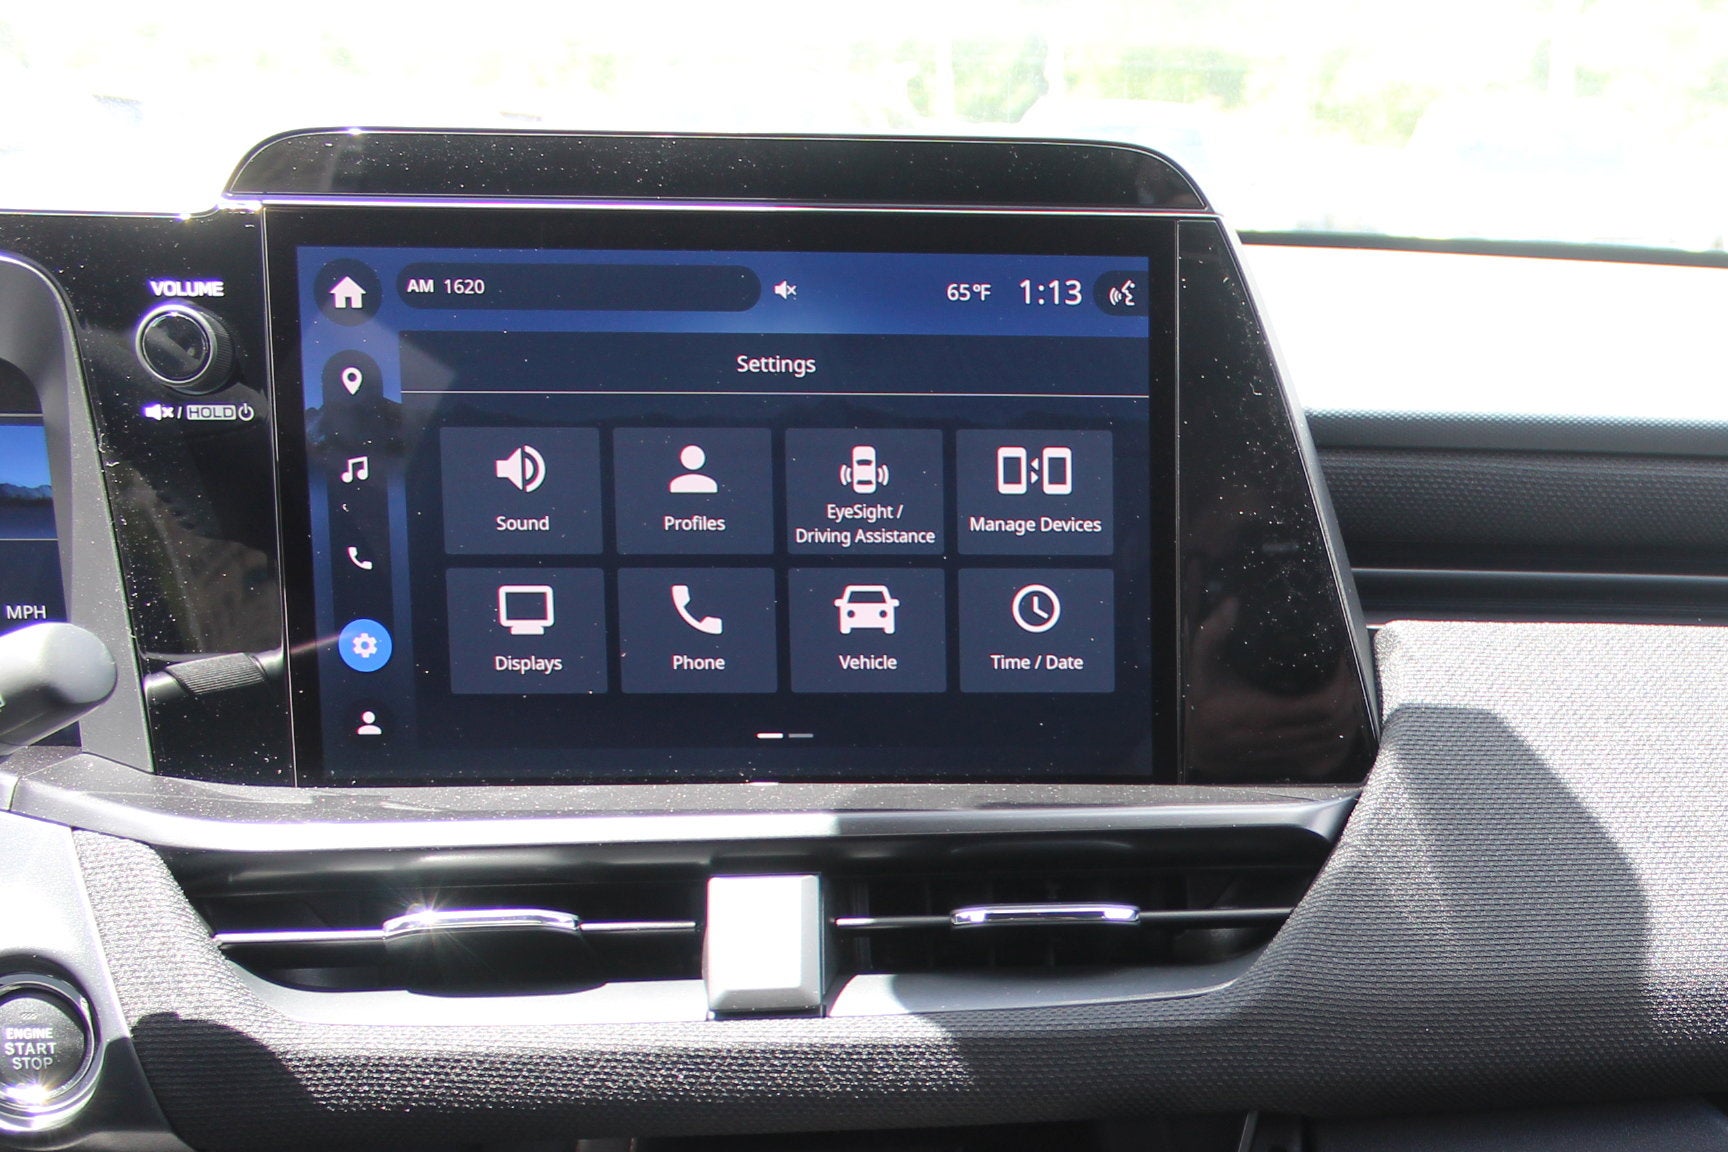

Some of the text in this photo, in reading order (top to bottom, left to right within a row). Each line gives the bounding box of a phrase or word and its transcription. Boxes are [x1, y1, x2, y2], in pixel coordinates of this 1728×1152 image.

[150, 280, 224, 298] VOLUME
[406, 279, 486, 295] AM 1620
[1019, 278, 1083, 306] 1:13
[736, 355, 816, 378] Settings
[188, 406, 235, 419] HOLD
[826, 503, 895, 524] EyeSight
[496, 515, 550, 532] Sound
[663, 515, 726, 532] Profiles
[969, 517, 1103, 537] Manage Devices
[795, 528, 936, 548] Driving Assistance
[6, 605, 47, 620] MPH
[494, 655, 563, 675] Displays
[672, 655, 726, 671] Phone
[838, 654, 899, 671] Vehicle
[989, 654, 1032, 671] Time
[1045, 654, 1085, 671] Date
[6, 1027, 54, 1040] ENGINE
[4, 1041, 57, 1056] START
[12, 1056, 53, 1071] STOP
